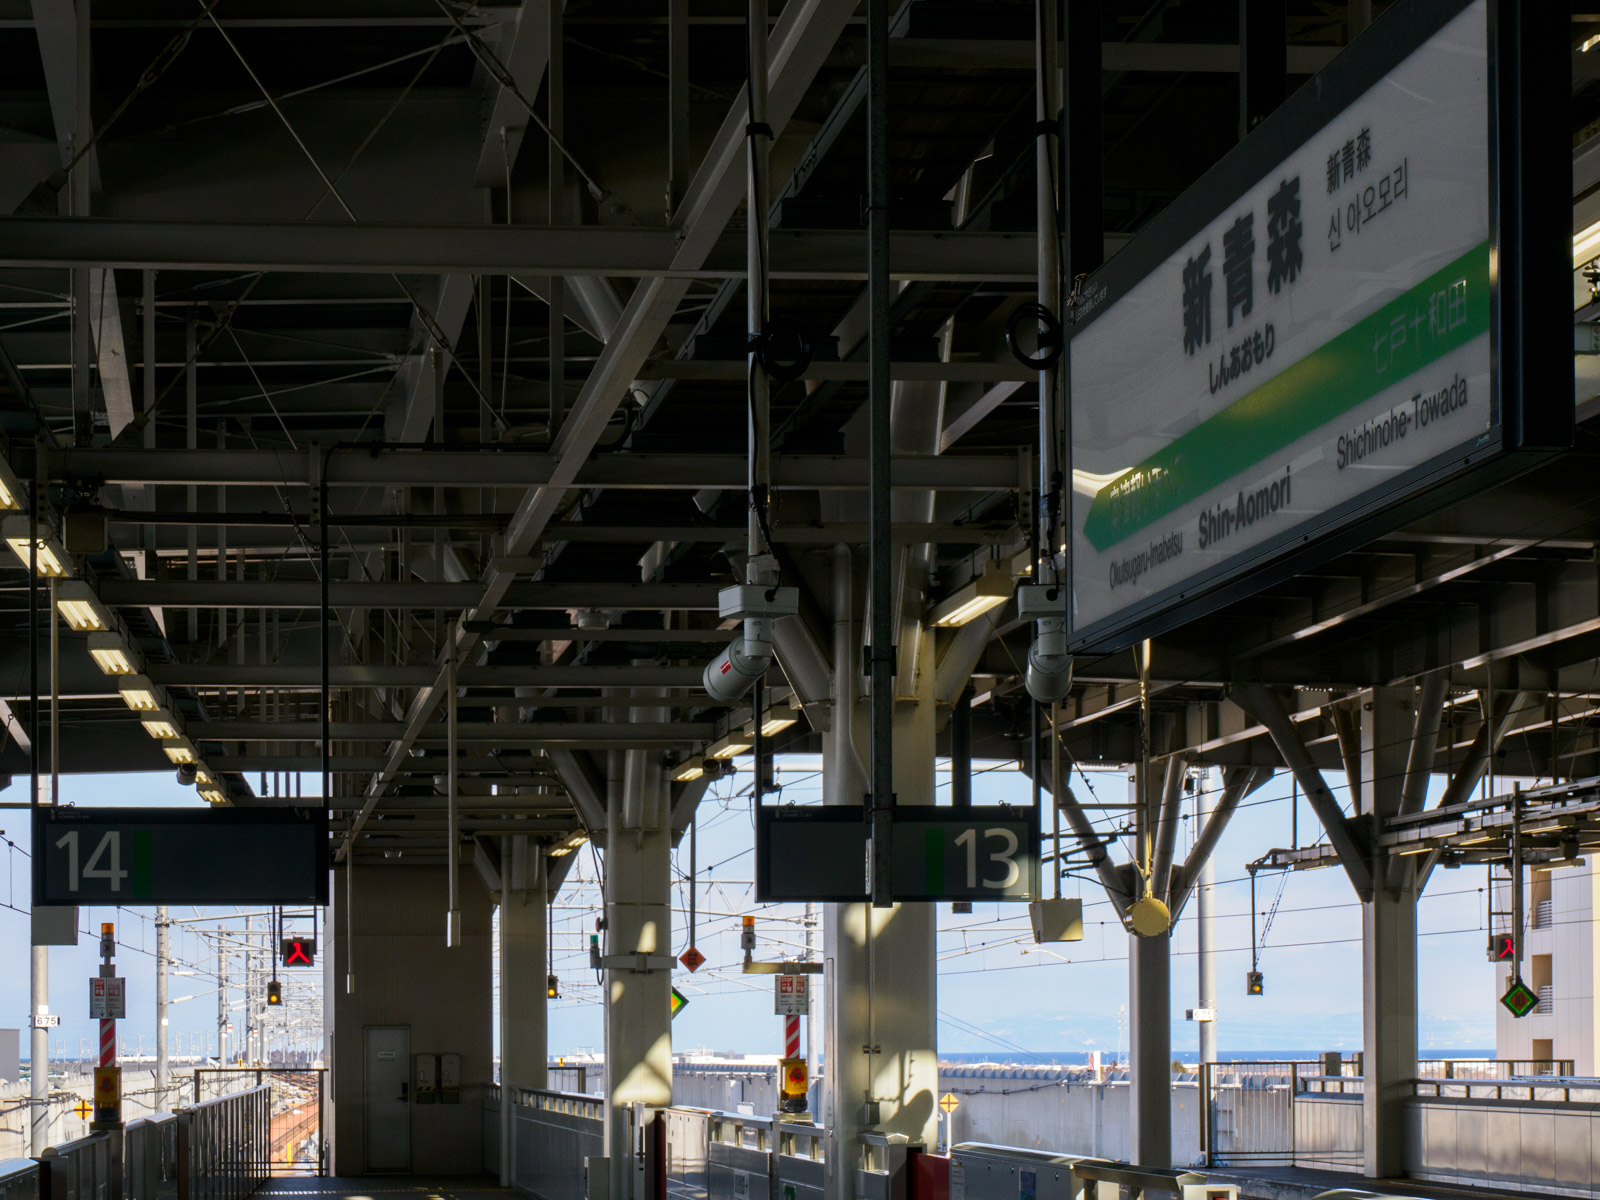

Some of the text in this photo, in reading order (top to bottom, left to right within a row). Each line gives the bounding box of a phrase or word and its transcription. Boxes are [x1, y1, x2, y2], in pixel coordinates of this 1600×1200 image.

[1327, 127, 1370, 195] 新青森
[1328, 157, 1408, 252] 신 아오모리
[1182, 175, 1304, 357] 新青森
[1209, 322, 1275, 395] しんあおもり
[1372, 275, 1467, 375] 七戸十和田
[1336, 372, 1468, 471] Shichinohe-Towada
[1198, 464, 1292, 550] Shin-Aomori
[1109, 531, 1183, 590] Okutsugaru-Imabetsu
[55, 830, 128, 892] 14
[954, 827, 1020, 890] 13
[37, 1016, 57, 1026] 675
